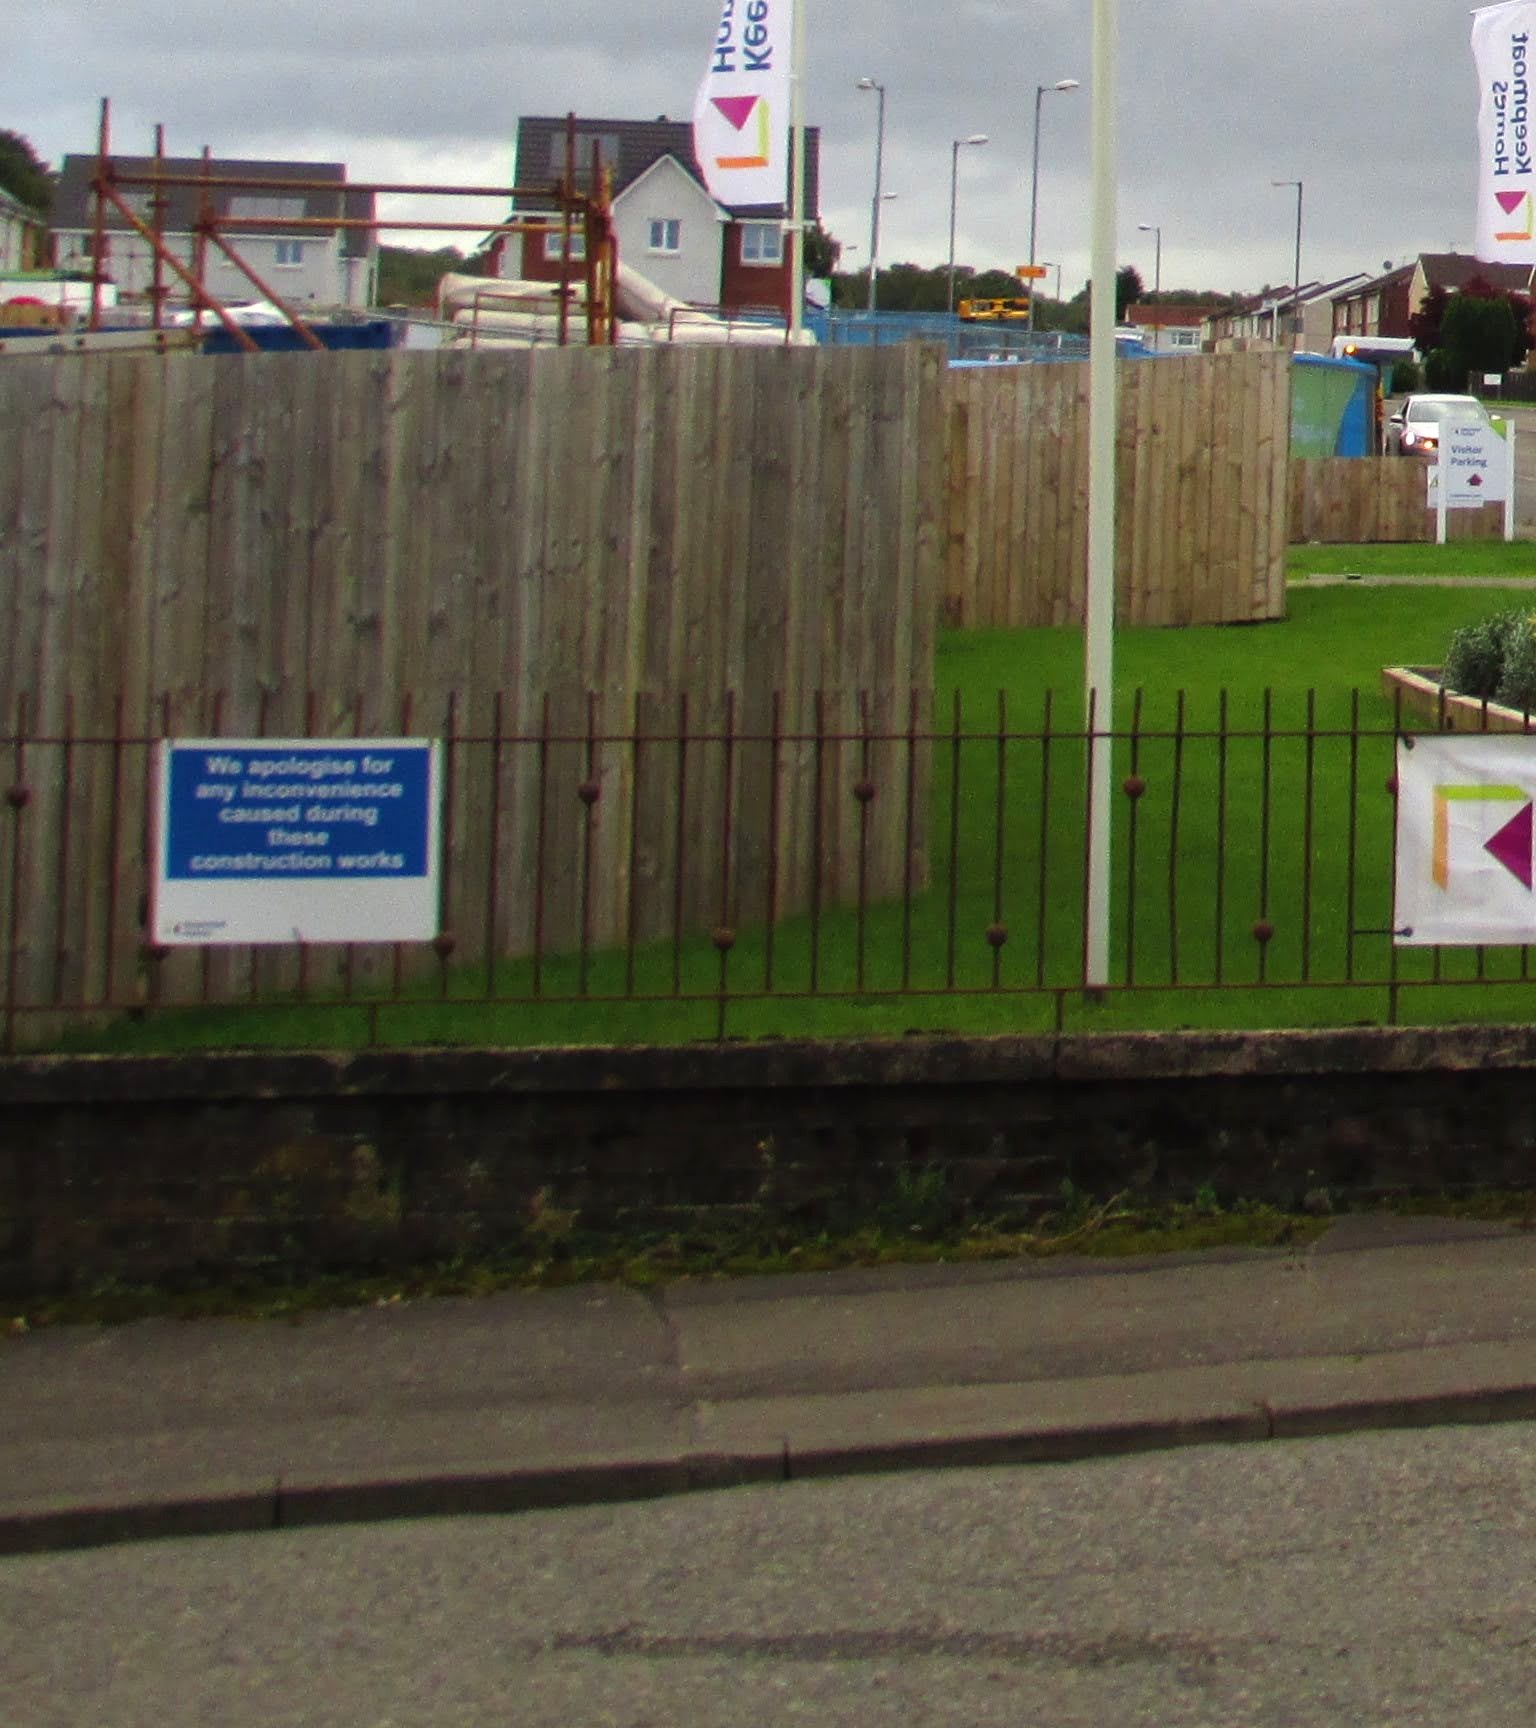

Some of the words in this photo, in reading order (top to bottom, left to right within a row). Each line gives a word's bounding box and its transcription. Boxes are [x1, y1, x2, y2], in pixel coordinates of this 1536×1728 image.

[1450, 457, 1487, 468] Parking
[207, 756, 241, 774] We
[248, 756, 355, 778] apologise
[361, 755, 393, 774] for
[196, 783, 234, 802] any
[242, 781, 403, 798] inconvenience
[218, 805, 299, 822] caused
[305, 805, 378, 826] during
[268, 828, 329, 846] these
[190, 850, 332, 870] construction
[337, 849, 404, 869] works
